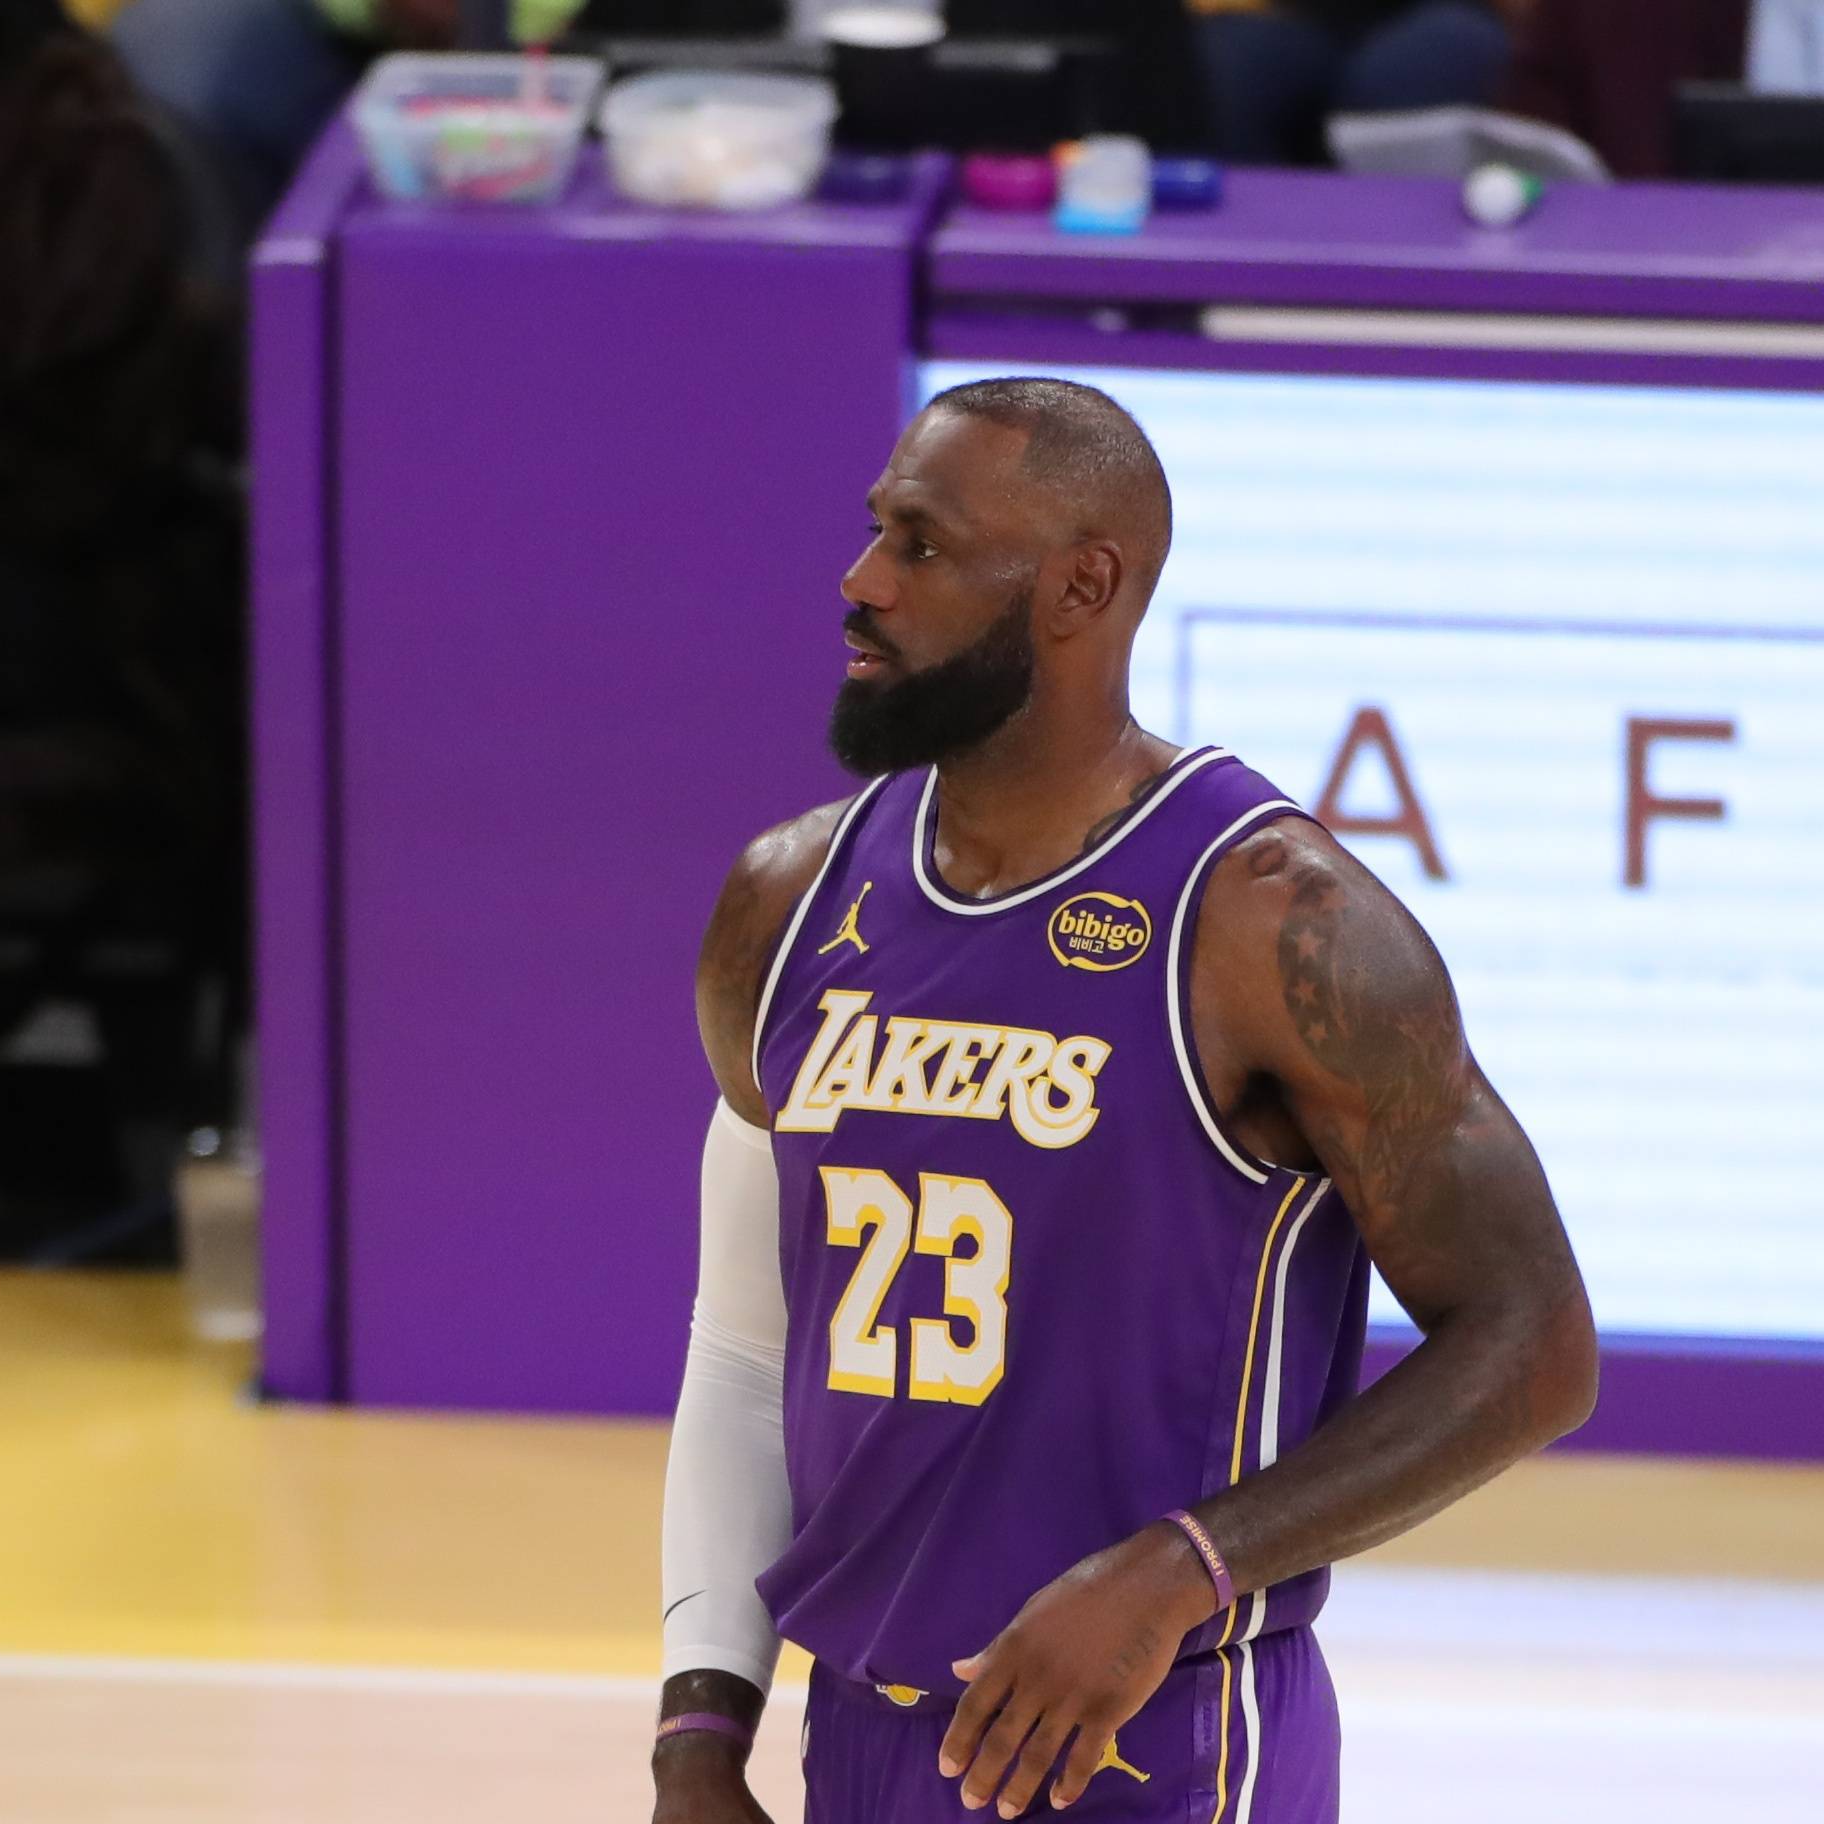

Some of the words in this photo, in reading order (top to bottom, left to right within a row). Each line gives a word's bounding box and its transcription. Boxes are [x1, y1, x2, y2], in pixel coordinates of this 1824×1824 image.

[1058, 909, 1145, 951] bibigo
[1069, 936, 1104, 954] 비비고
[776, 989, 1113, 1149] LAKERS
[819, 1165, 1013, 1407] 23
[1179, 1515, 1221, 1569] PROMISE
